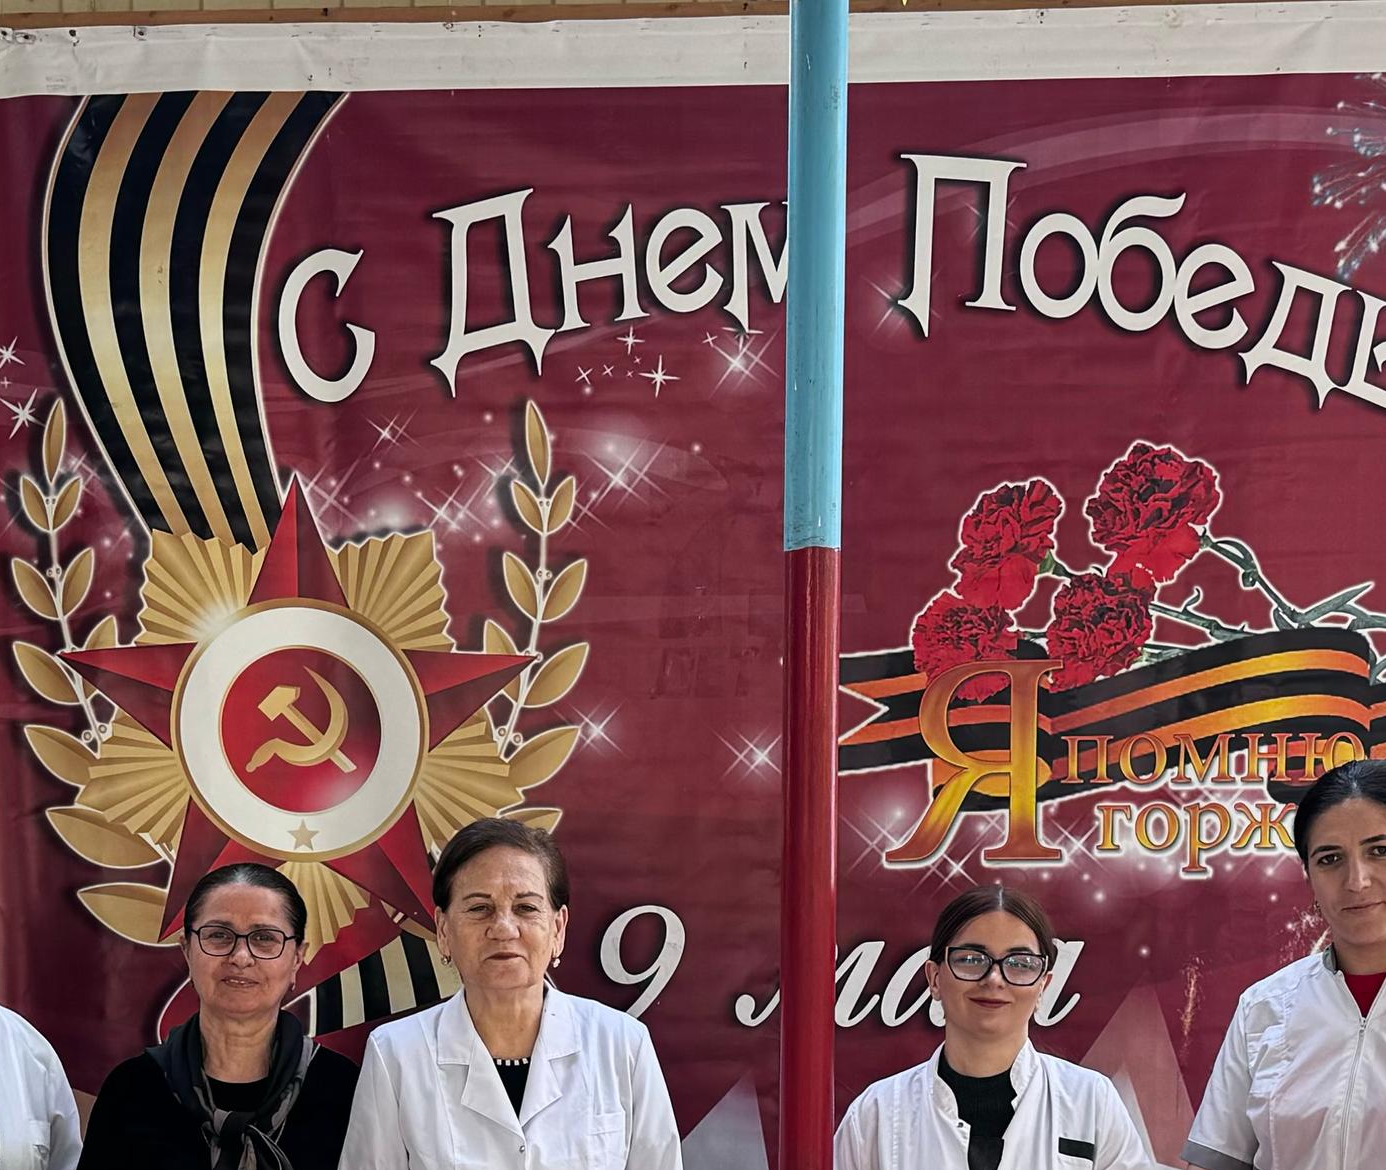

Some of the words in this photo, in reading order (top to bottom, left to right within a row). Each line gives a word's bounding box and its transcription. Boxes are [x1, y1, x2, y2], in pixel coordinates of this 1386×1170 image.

[885, 659, 1064, 865] Я
[1061, 730, 1367, 785] помню
[598, 904, 687, 1018] 9
